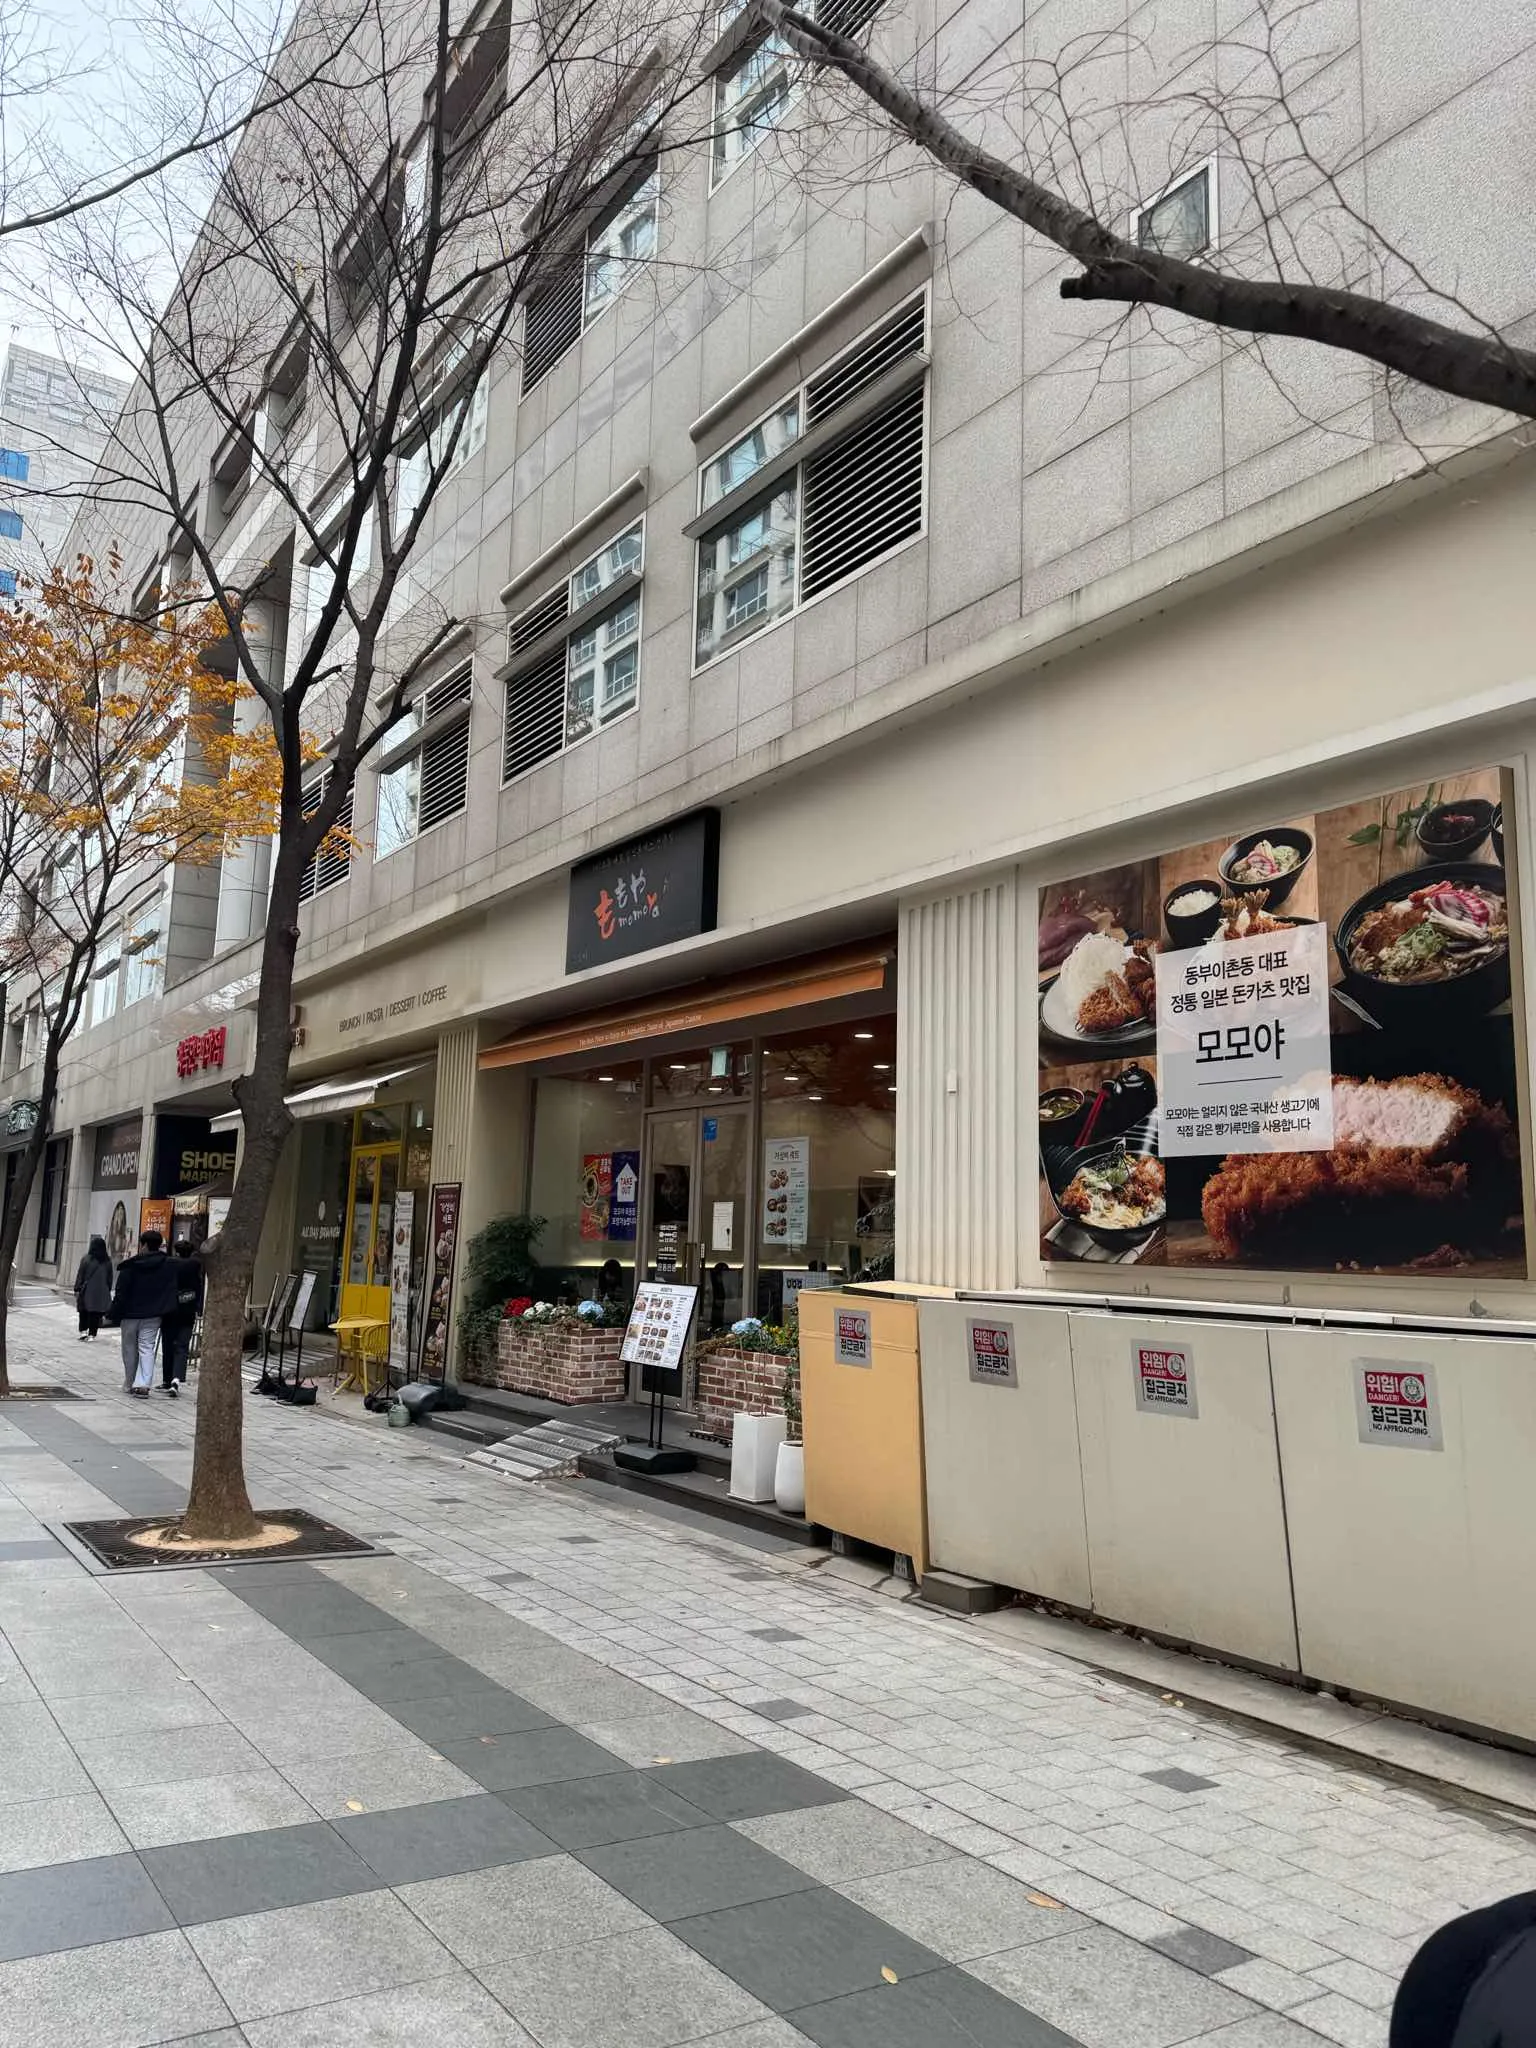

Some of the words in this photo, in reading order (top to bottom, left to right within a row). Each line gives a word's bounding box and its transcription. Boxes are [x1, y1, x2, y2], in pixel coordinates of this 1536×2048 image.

[594, 868, 646, 939] ももや
[1185, 955, 1254, 985] 동부이촌동
[1258, 951, 1288, 972] 대표
[1171, 992, 1198, 1013] 정통
[1201, 987, 1228, 1009] 일본
[1232, 980, 1276, 1004] 돈카츠
[1280, 974, 1310, 997] 맛집
[339, 1016, 361, 1033] BRUNCH
[366, 1007, 384, 1025] PASTA
[390, 995, 416, 1017] DESSERT
[422, 985, 448, 1006] COFFEE
[1196, 1019, 1285, 1063] 모모야
[1166, 1107, 1199, 1120] 모모야는
[1201, 1105, 1228, 1118] 얼리지
[1230, 1103, 1248, 1117] 않은
[1250, 1102, 1278, 1115] 국내산
[1281, 1098, 1320, 1113] 생고기에
[1176, 1126, 1194, 1138] 직접
[1195, 1124, 1213, 1137] 갈은
[1263, 1117, 1311, 1134] 사용합니다
[101, 1153, 121, 1176] GRAND
[620, 1177, 632, 1186] TAKE
[977, 1353, 1008, 1370] 접근금지
[1145, 1379, 1187, 1398] 접근금지
[1367, 1374, 1399, 1393] 위험!
[1371, 1405, 1427, 1427] 접근금지
[1373, 1423, 1383, 1431] NO
[1384, 1424, 1428, 1435] APPROACHING
